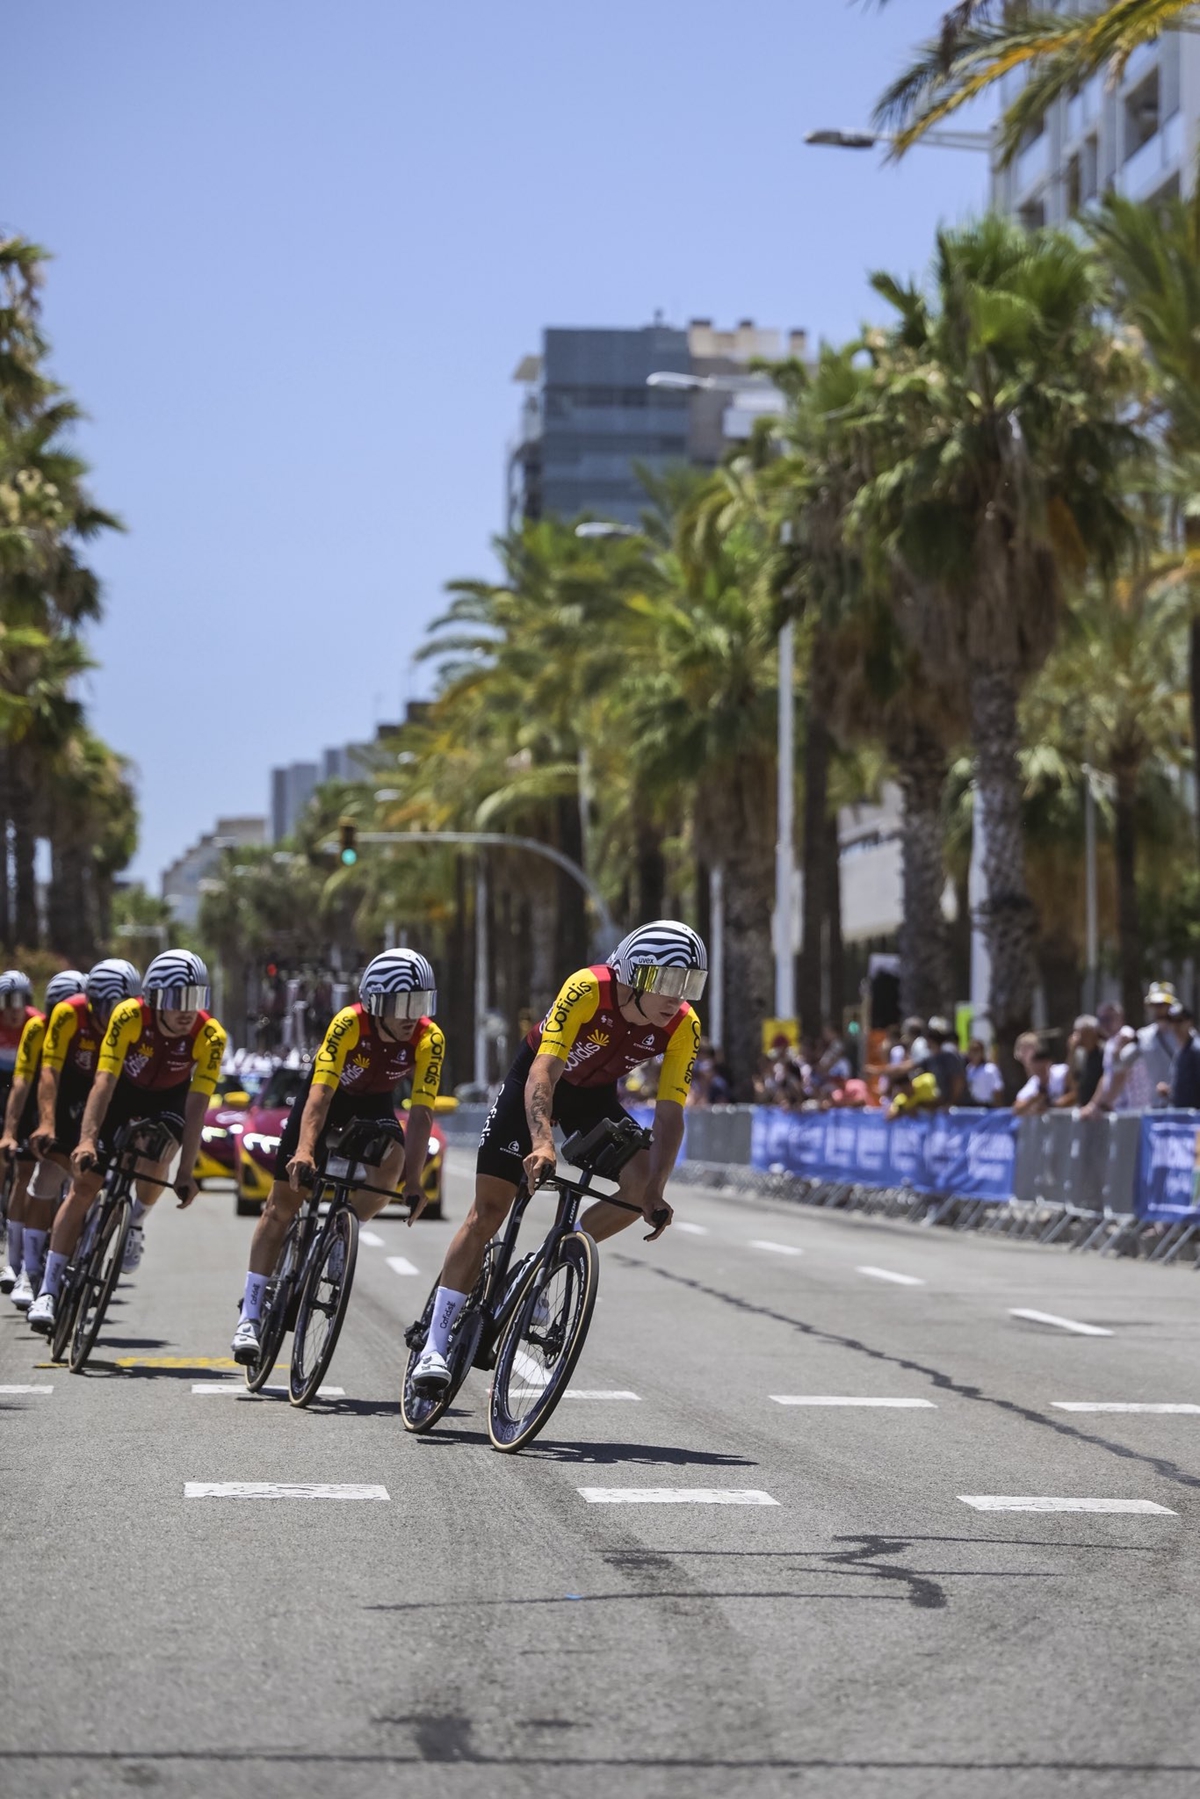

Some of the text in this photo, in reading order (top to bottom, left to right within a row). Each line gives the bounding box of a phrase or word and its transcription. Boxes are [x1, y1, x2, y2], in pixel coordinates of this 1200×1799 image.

[106, 1007, 140, 1048] Cofidis
[545, 981, 592, 1033] Cofidis
[319, 1016, 354, 1063] Cofidis
[424, 1033, 444, 1086] Cofidis
[568, 1200, 578, 1224] LOOK
[440, 1304, 454, 1330] Cofidis
